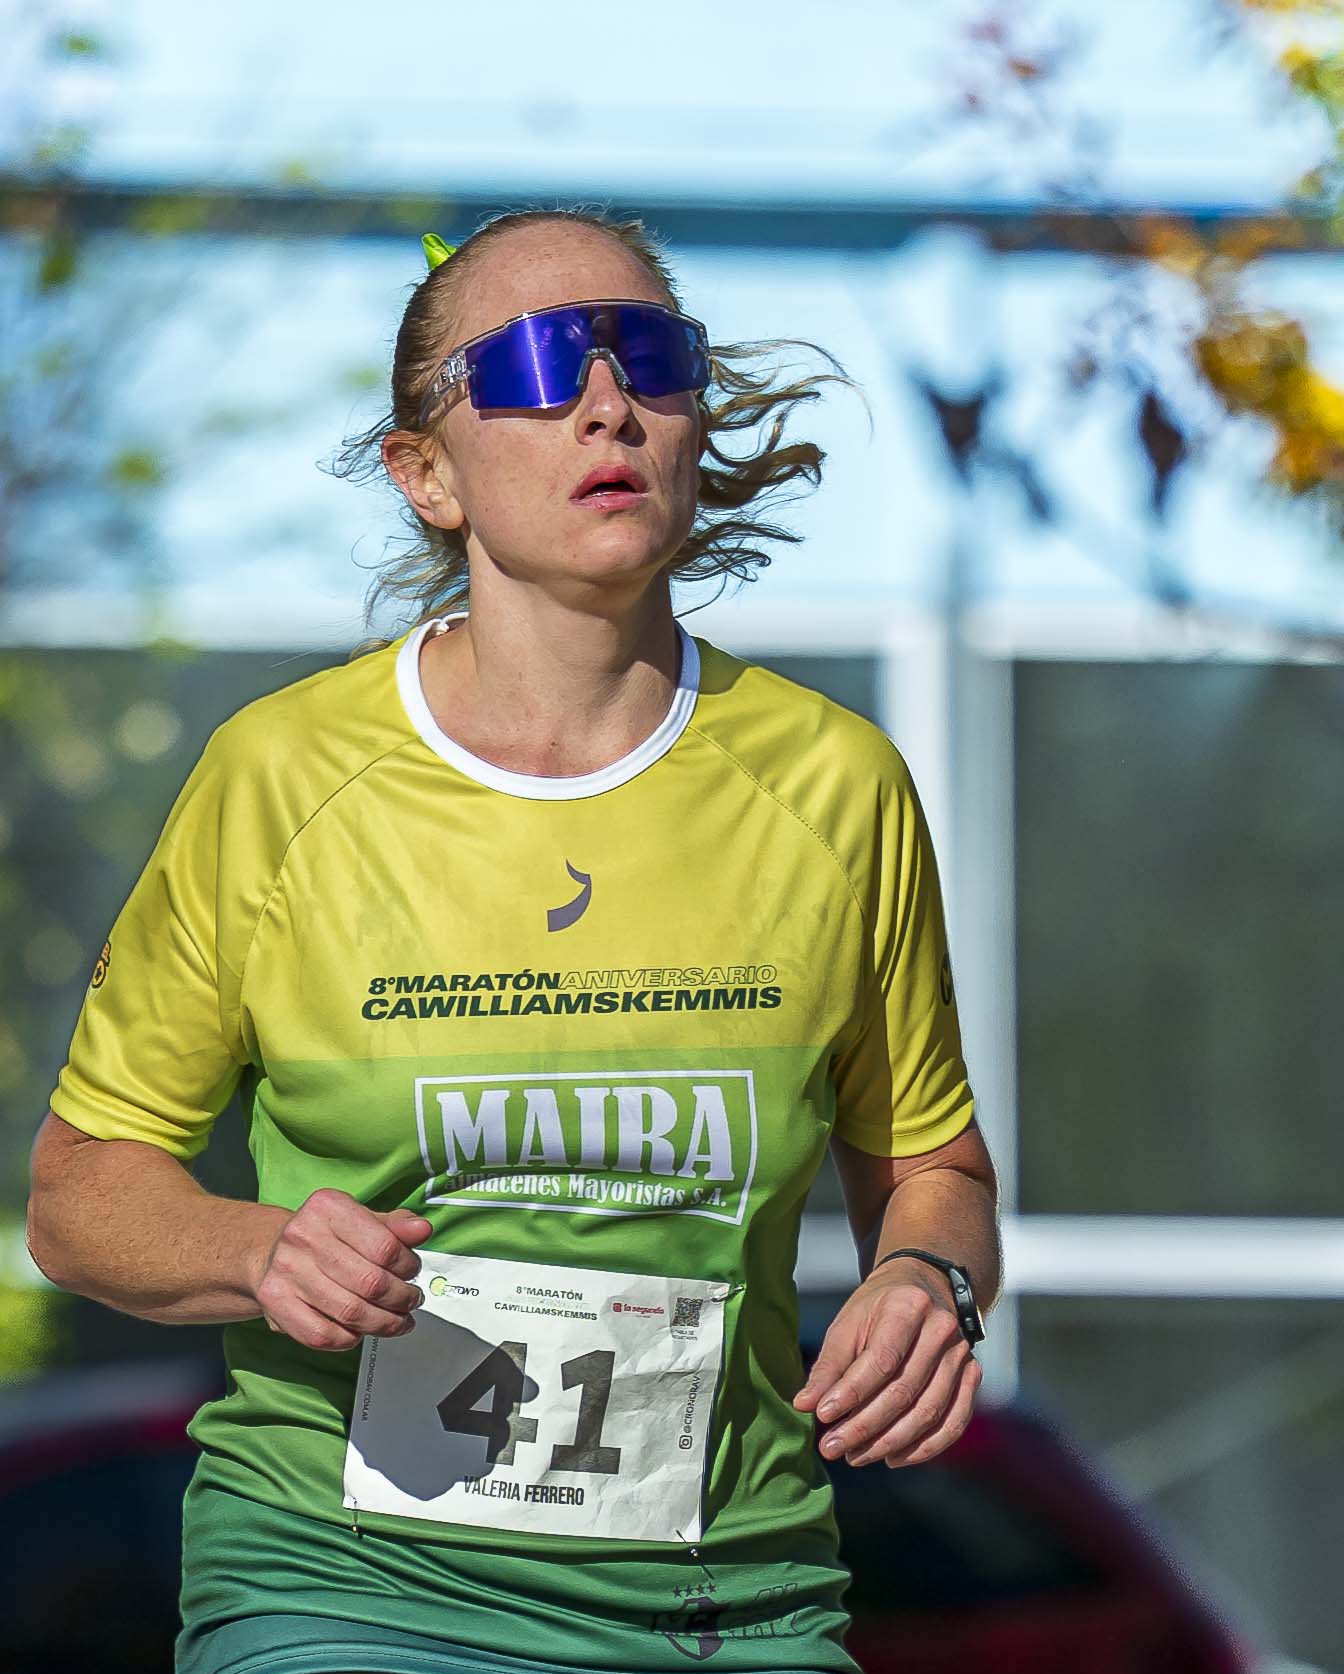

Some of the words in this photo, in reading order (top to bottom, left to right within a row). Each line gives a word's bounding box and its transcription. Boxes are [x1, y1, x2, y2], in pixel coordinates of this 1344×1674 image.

[361, 985, 783, 1021] CAWILLIAMSKEMMIS
[435, 1084, 736, 1182] MAIRA
[568, 1173, 686, 1207] Mayoristas
[436, 1340, 622, 1475] 41
[463, 1475, 521, 1502] VALERIA
[523, 1484, 585, 1506] FERRERO
